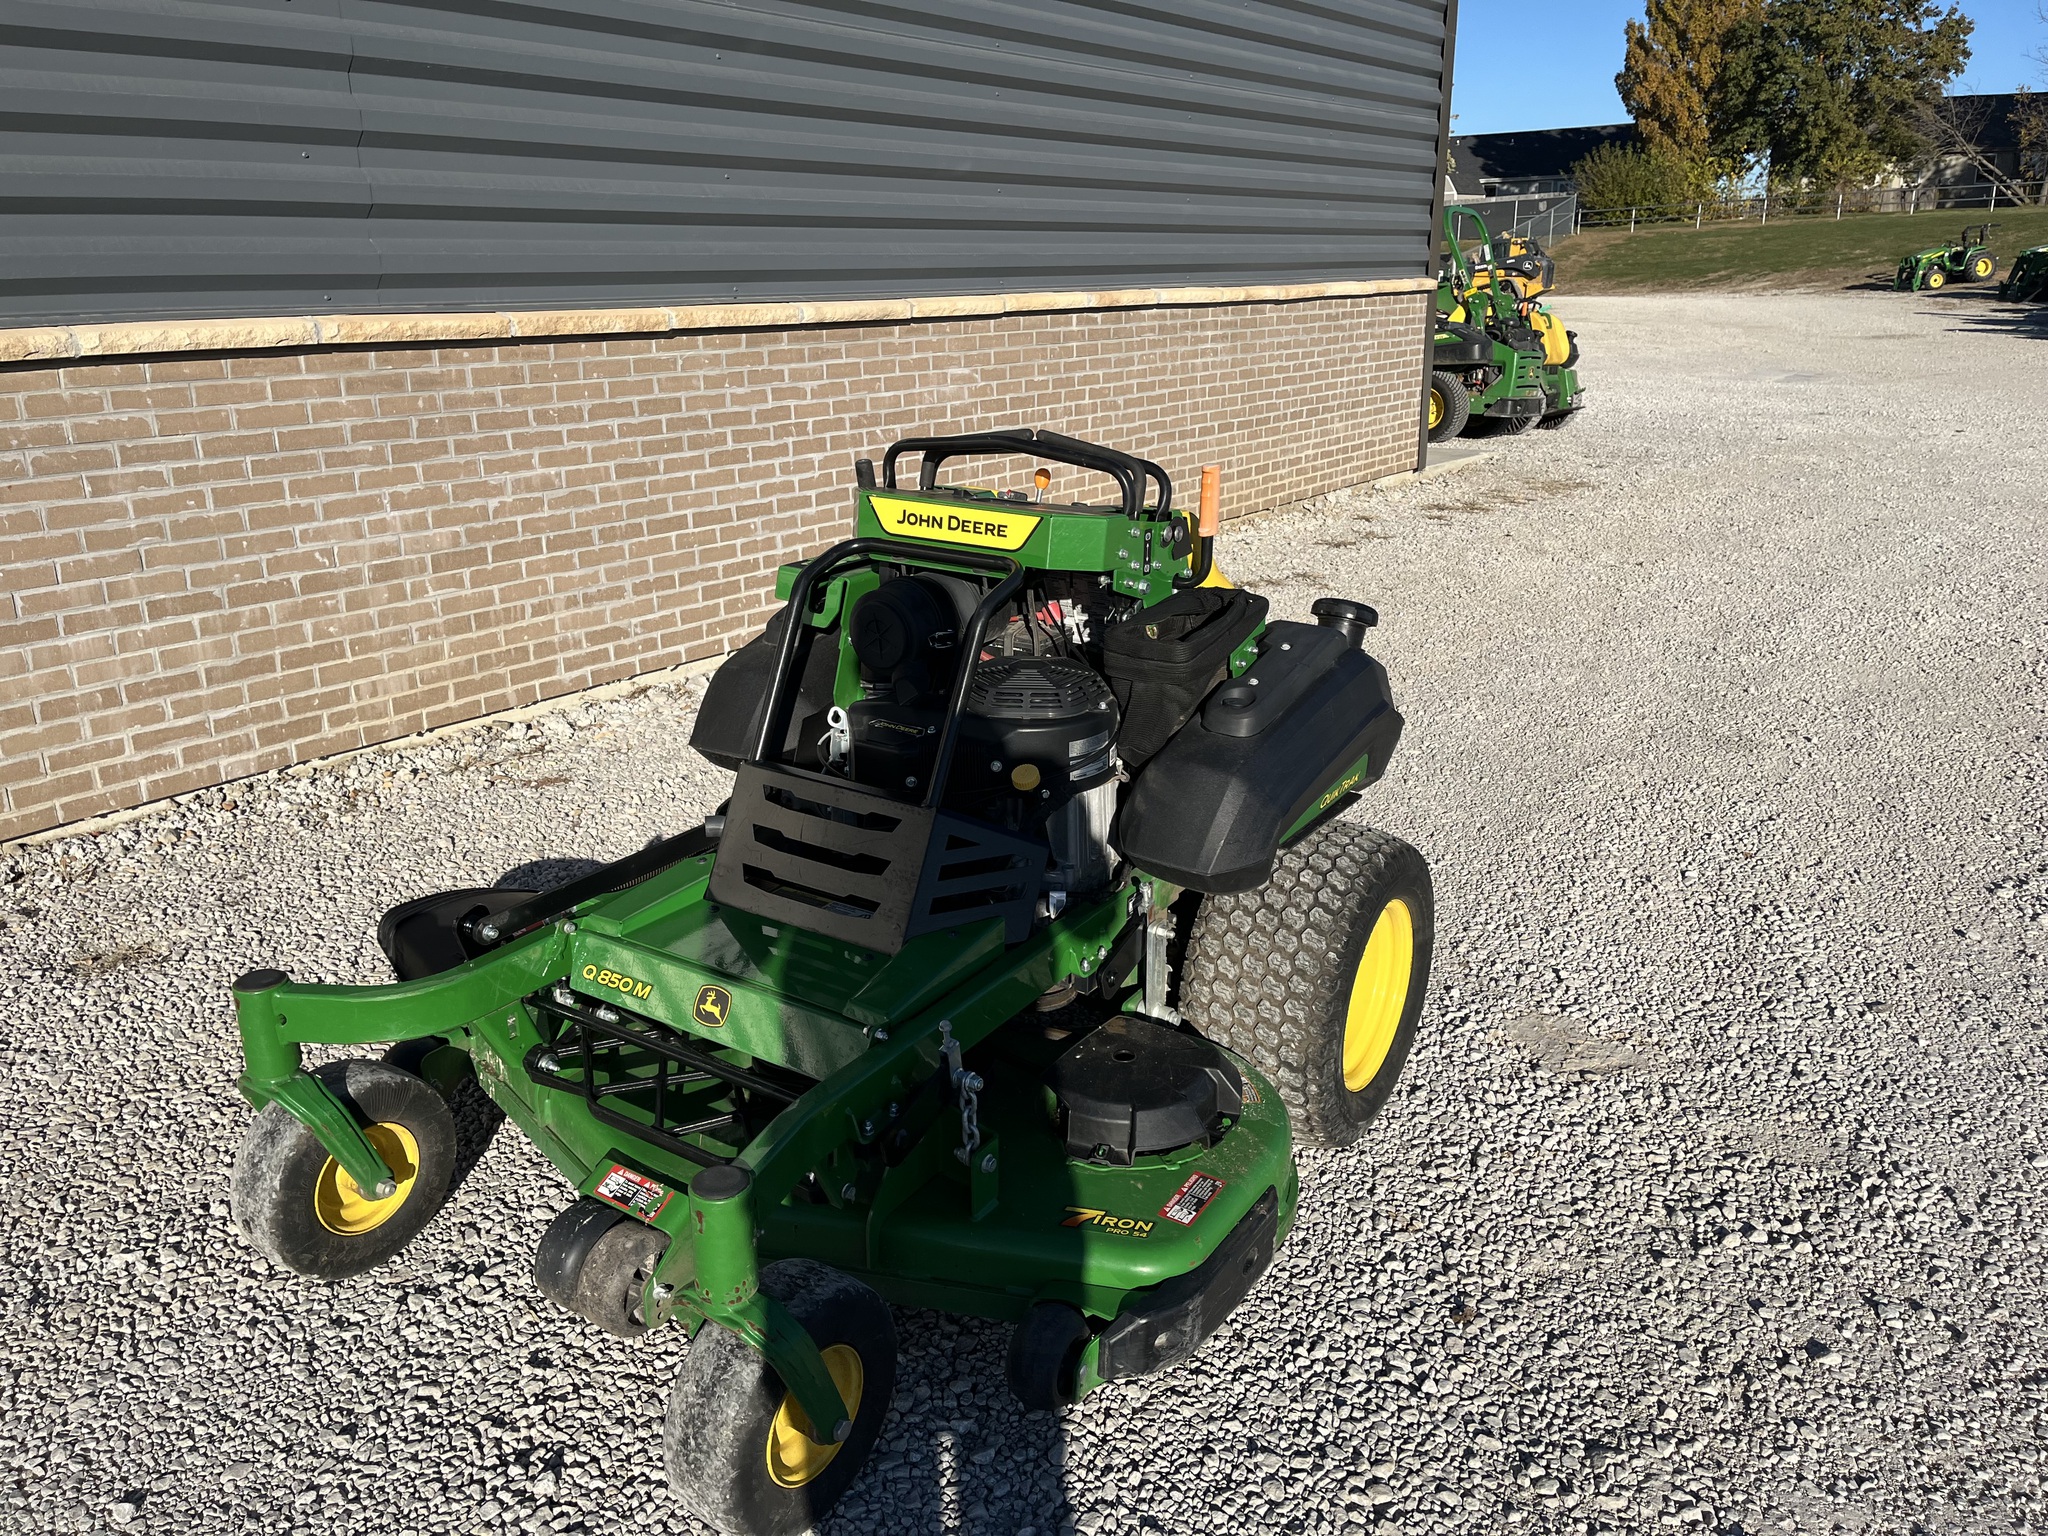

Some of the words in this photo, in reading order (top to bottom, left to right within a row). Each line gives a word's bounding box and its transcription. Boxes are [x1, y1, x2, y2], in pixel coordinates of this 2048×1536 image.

[897, 509, 943, 529] JOHN
[948, 515, 1008, 538] DEERE
[896, 724, 919, 734] DEERE
[582, 964, 598, 981] Q
[597, 969, 634, 992] 850
[632, 981, 653, 1000] M
[623, 1171, 641, 1183] DANGER
[1105, 1227, 1130, 1235] PRO
